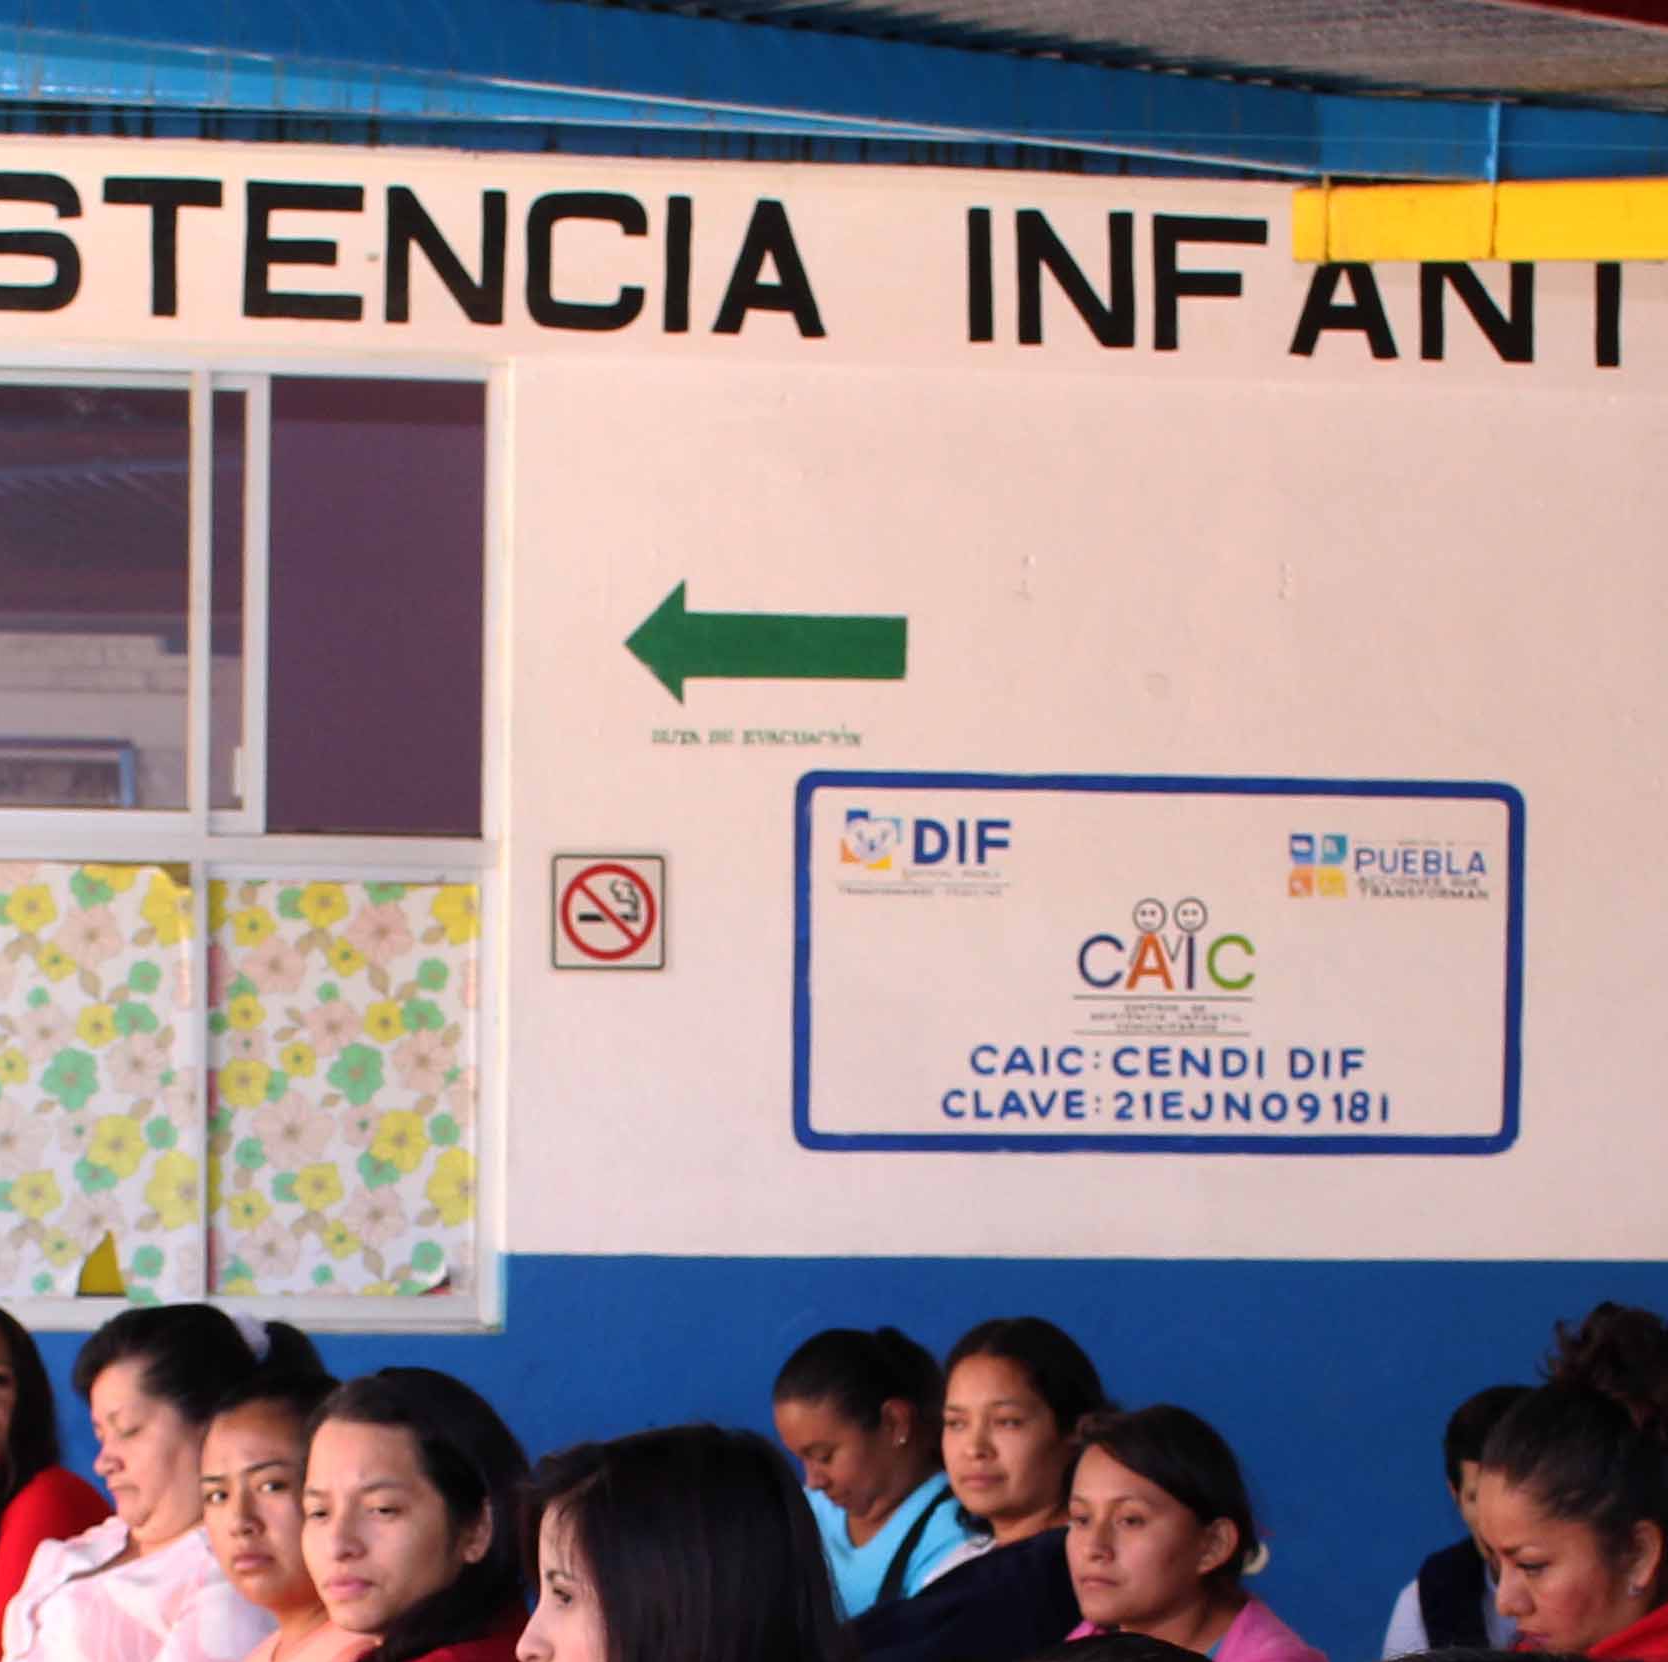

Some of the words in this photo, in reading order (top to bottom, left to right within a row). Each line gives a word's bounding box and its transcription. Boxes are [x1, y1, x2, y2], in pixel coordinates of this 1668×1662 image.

[912, 816, 1012, 866] DIF
[1353, 847, 1488, 876] PUEBLA
[1078, 932, 1256, 990] CAIC
[1111, 1045, 1266, 1080] CENDI
[1288, 1047, 1367, 1081] DIF
